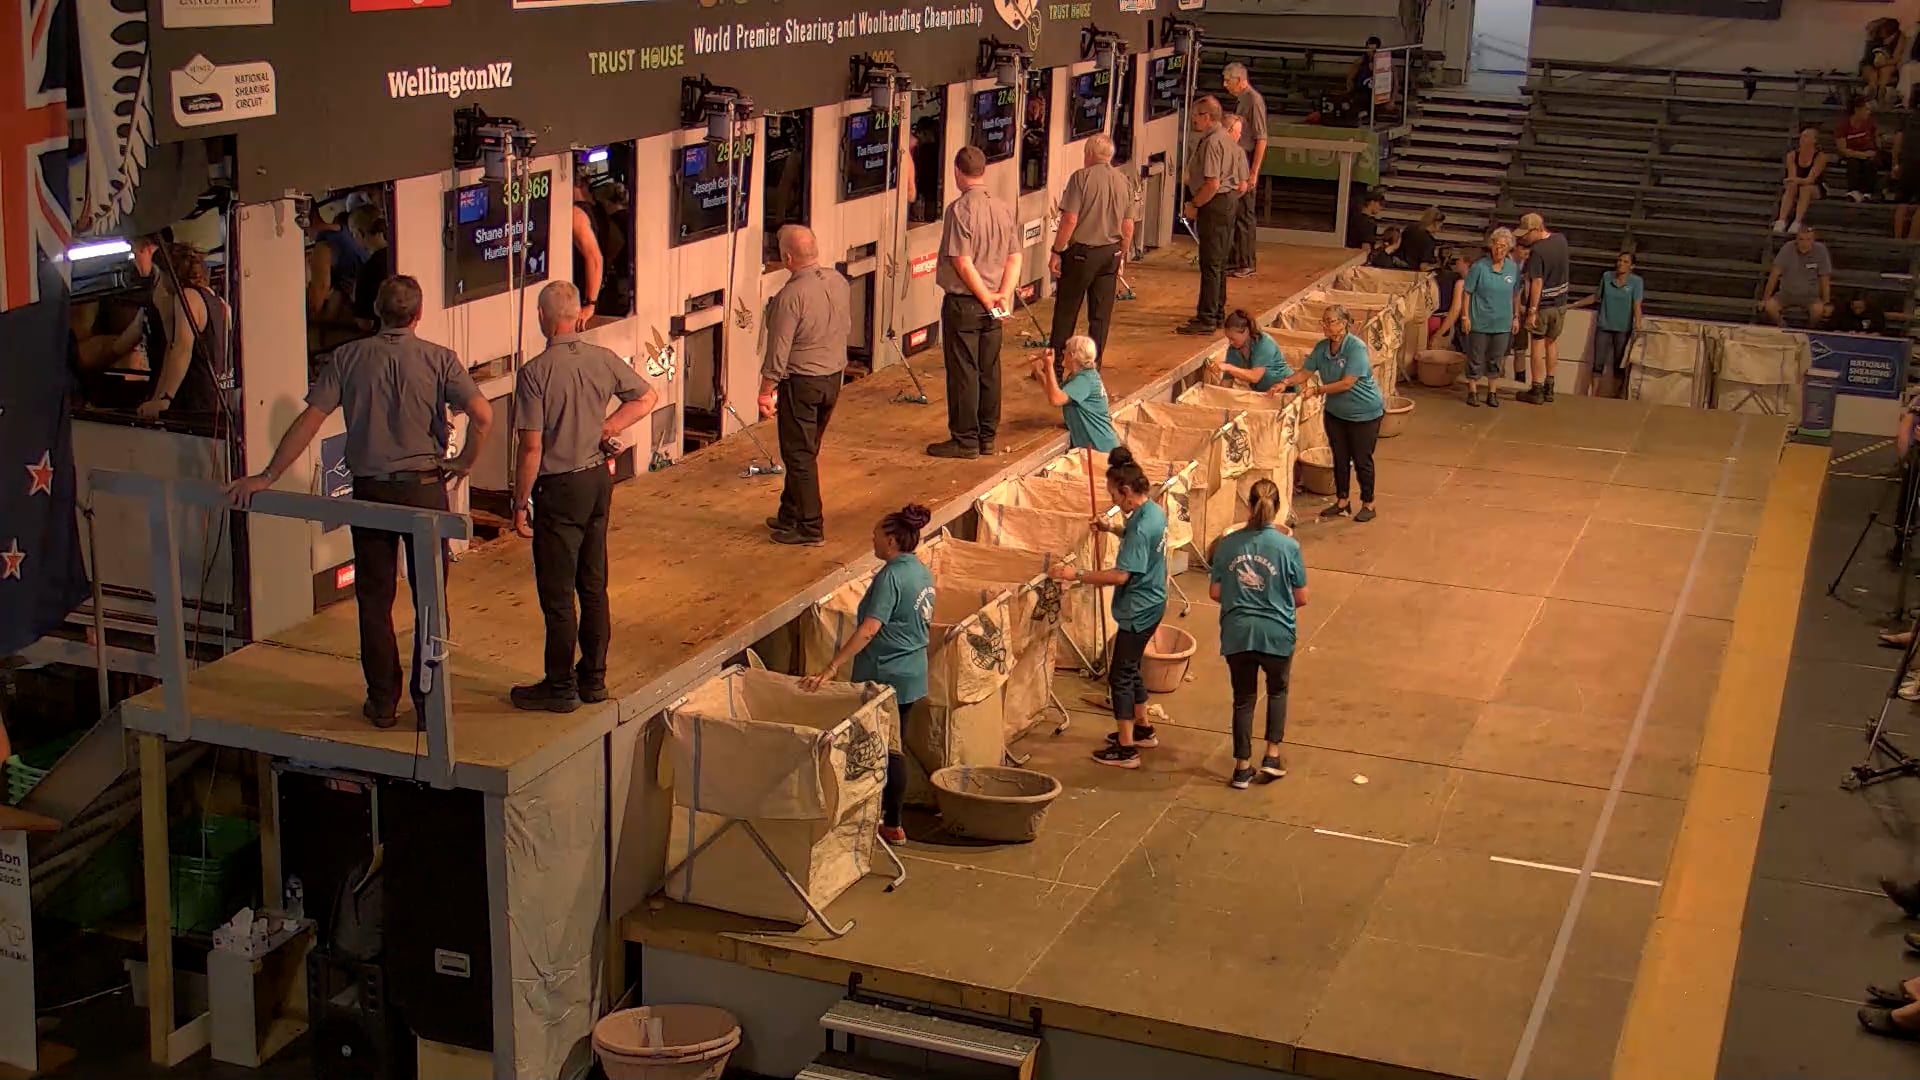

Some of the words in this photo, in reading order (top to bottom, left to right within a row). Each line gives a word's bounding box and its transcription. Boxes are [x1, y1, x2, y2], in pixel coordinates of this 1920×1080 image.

[1049, 4, 1069, 20] TRUST
[694, 25, 731, 54] World
[736, 24, 781, 50] Premier
[785, 17, 834, 45] Shearing
[837, 16, 855, 37] and
[858, 9, 921, 34] Woolhandling
[924, 2, 984, 31] Championship
[588, 49, 635, 75] TRUST
[640, 44, 685, 70] HOUSE
[234, 73, 269, 84] NATIONAL
[387, 62, 513, 99] WellingtonNZ
[234, 84, 270, 97] SHEARING
[236, 97, 263, 110] CIRCUIT
[475, 227, 503, 244] Shane
[458, 279, 463, 294] 1
[1849, 359, 1891, 370] NATIONAL
[1848, 367, 1889, 378] SHEARING
[1847, 376, 1880, 385] CIRCUIT
